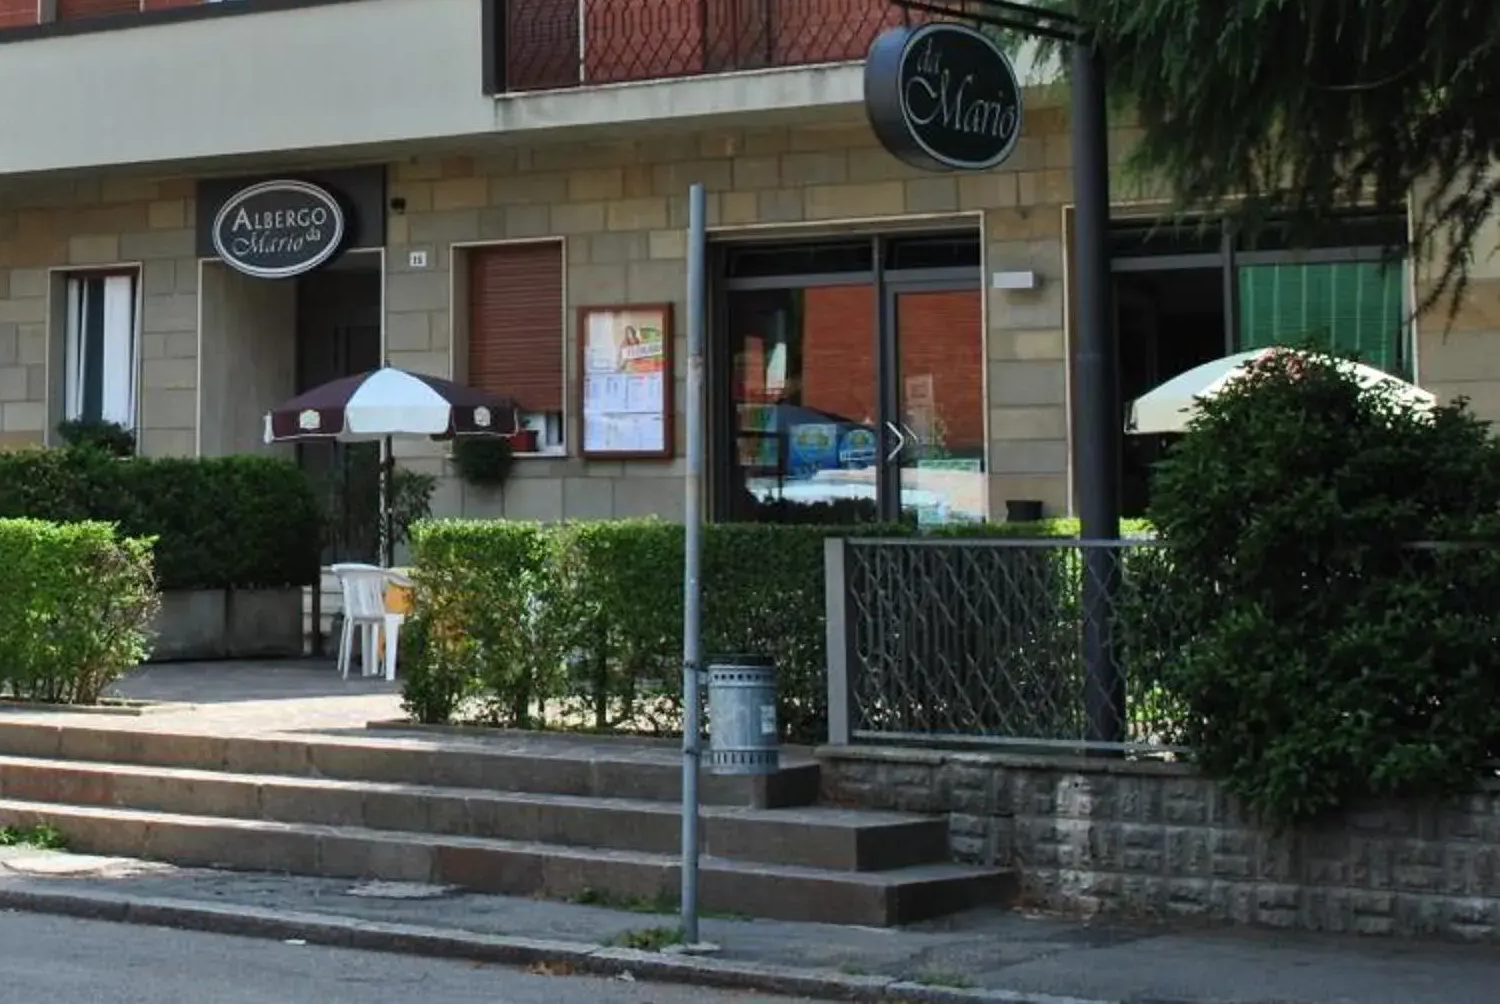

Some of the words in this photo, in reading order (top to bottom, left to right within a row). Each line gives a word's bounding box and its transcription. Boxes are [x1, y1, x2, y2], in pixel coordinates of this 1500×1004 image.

[916, 37, 942, 74] da
[905, 68, 1016, 139] Mario
[231, 230, 305, 256] Mario
